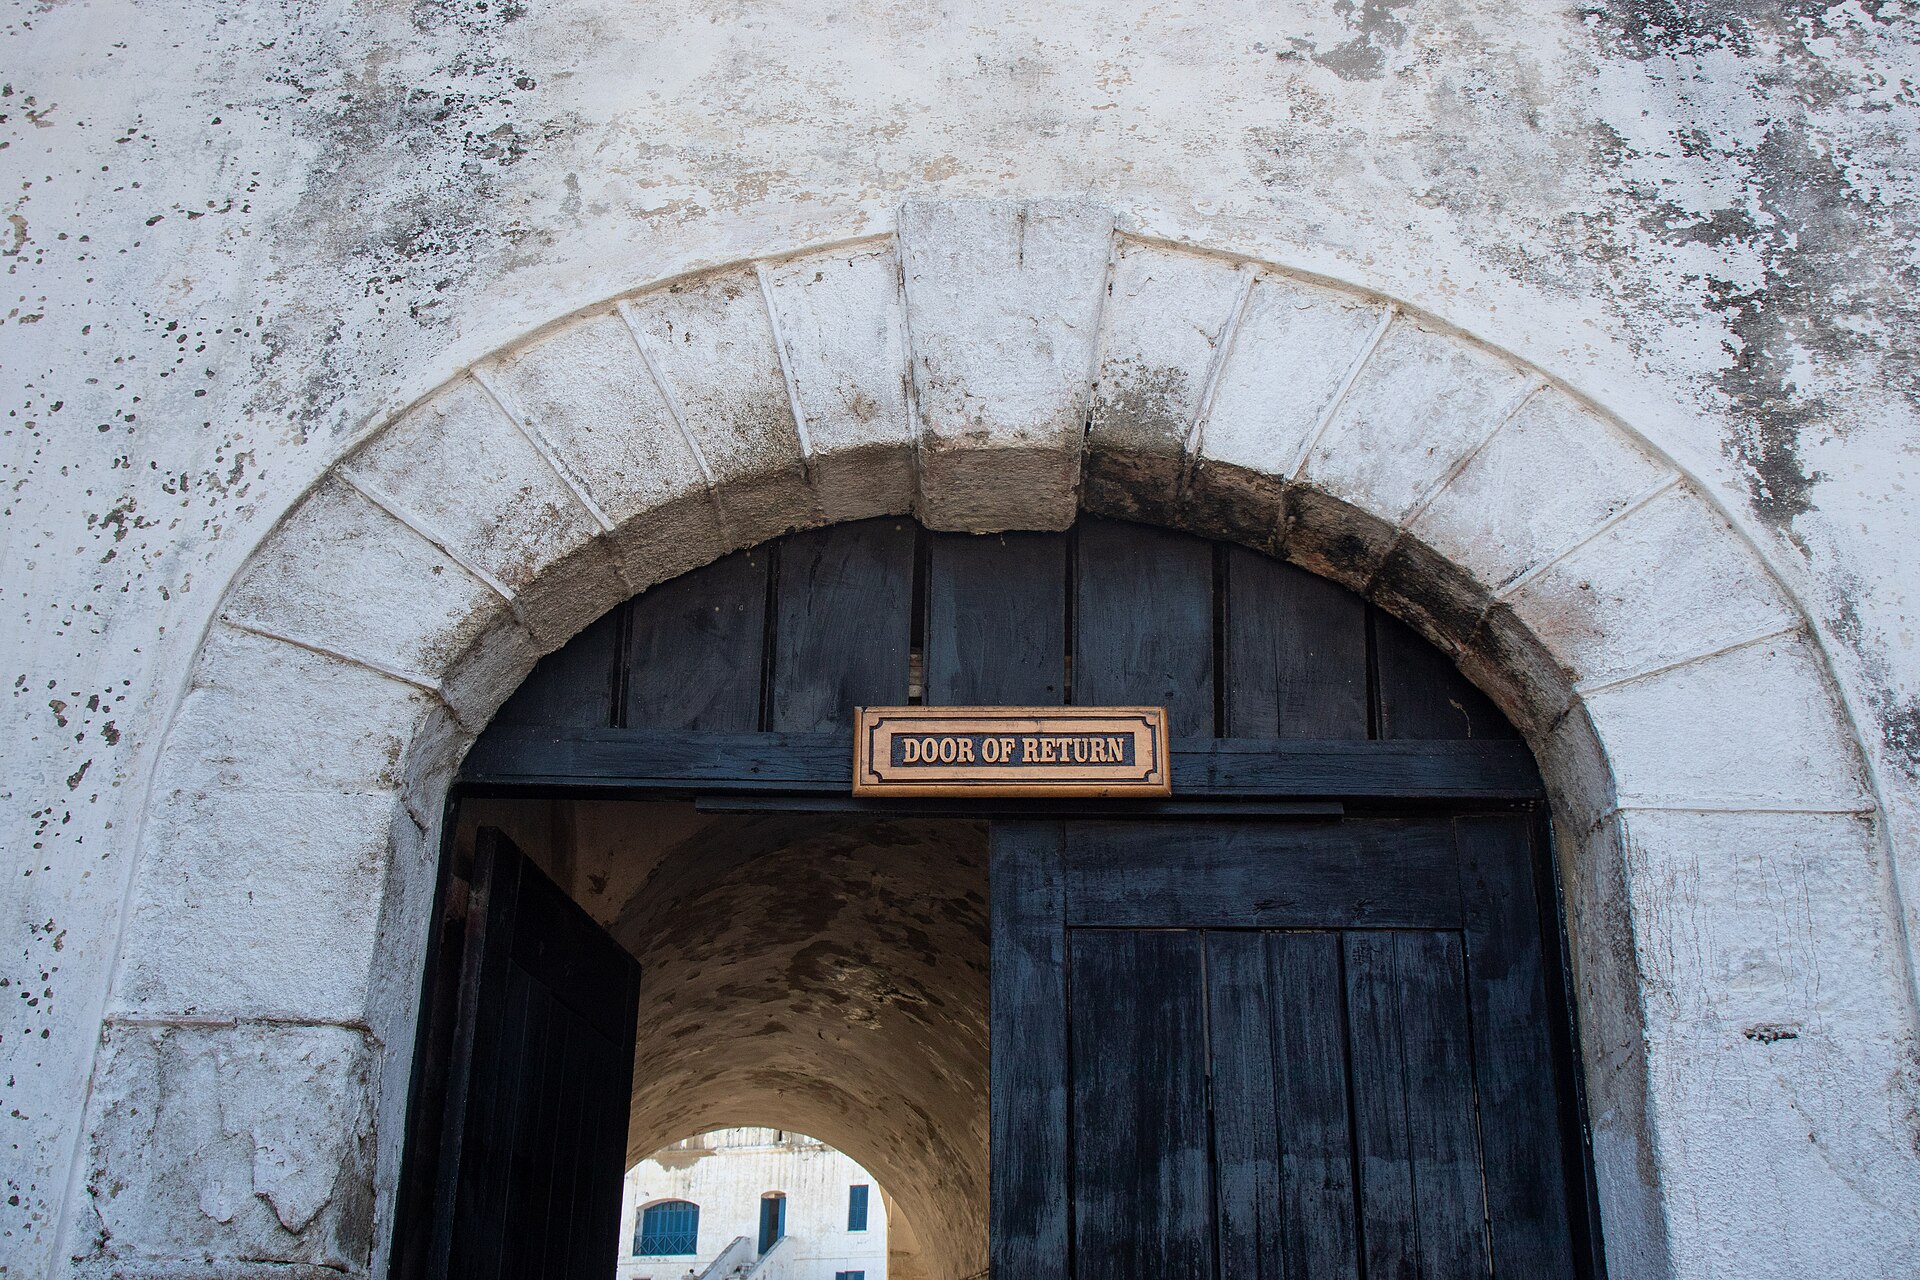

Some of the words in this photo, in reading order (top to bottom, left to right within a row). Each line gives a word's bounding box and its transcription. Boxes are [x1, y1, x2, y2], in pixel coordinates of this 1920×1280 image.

[903, 738, 975, 763] DOOR
[981, 738, 1016, 763] OF
[1021, 738, 1125, 763] RETURN
